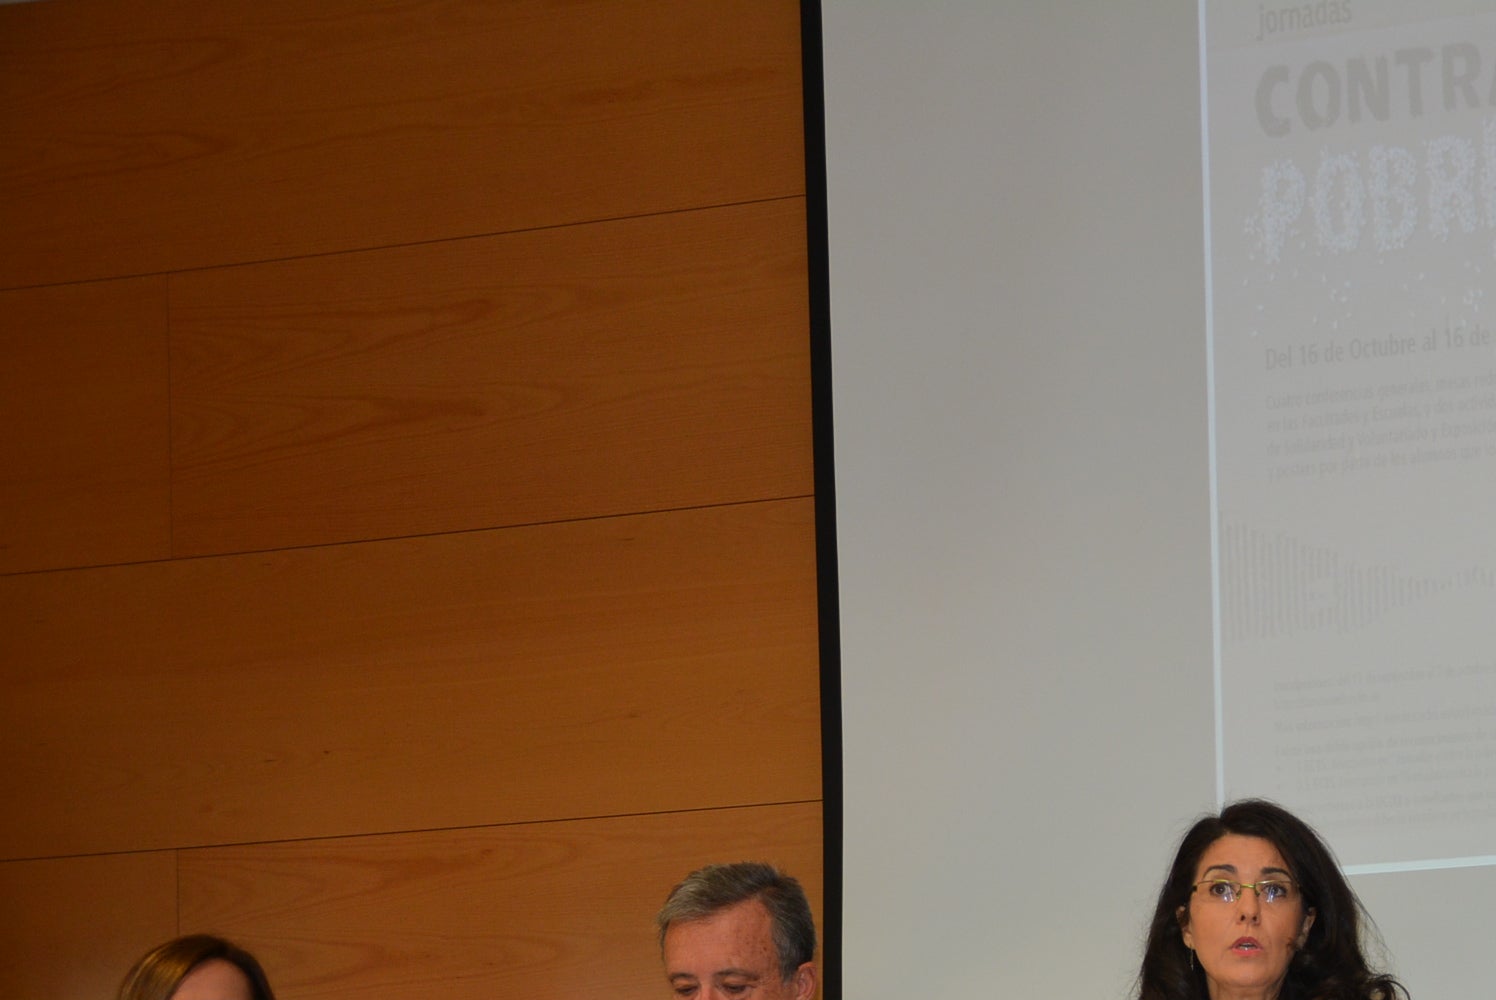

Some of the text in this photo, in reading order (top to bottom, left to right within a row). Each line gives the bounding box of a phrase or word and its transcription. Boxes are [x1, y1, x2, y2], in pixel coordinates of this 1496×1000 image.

[1256, 0, 1353, 41] jornadas
[1265, 345, 1293, 371] Del
[1299, 343, 1320, 368] 16
[1324, 339, 1345, 363] de
[1349, 333, 1417, 360] Octubre
[1421, 328, 1437, 352] al
[1444, 325, 1465, 349] 16
[1470, 322, 1491, 347] de
